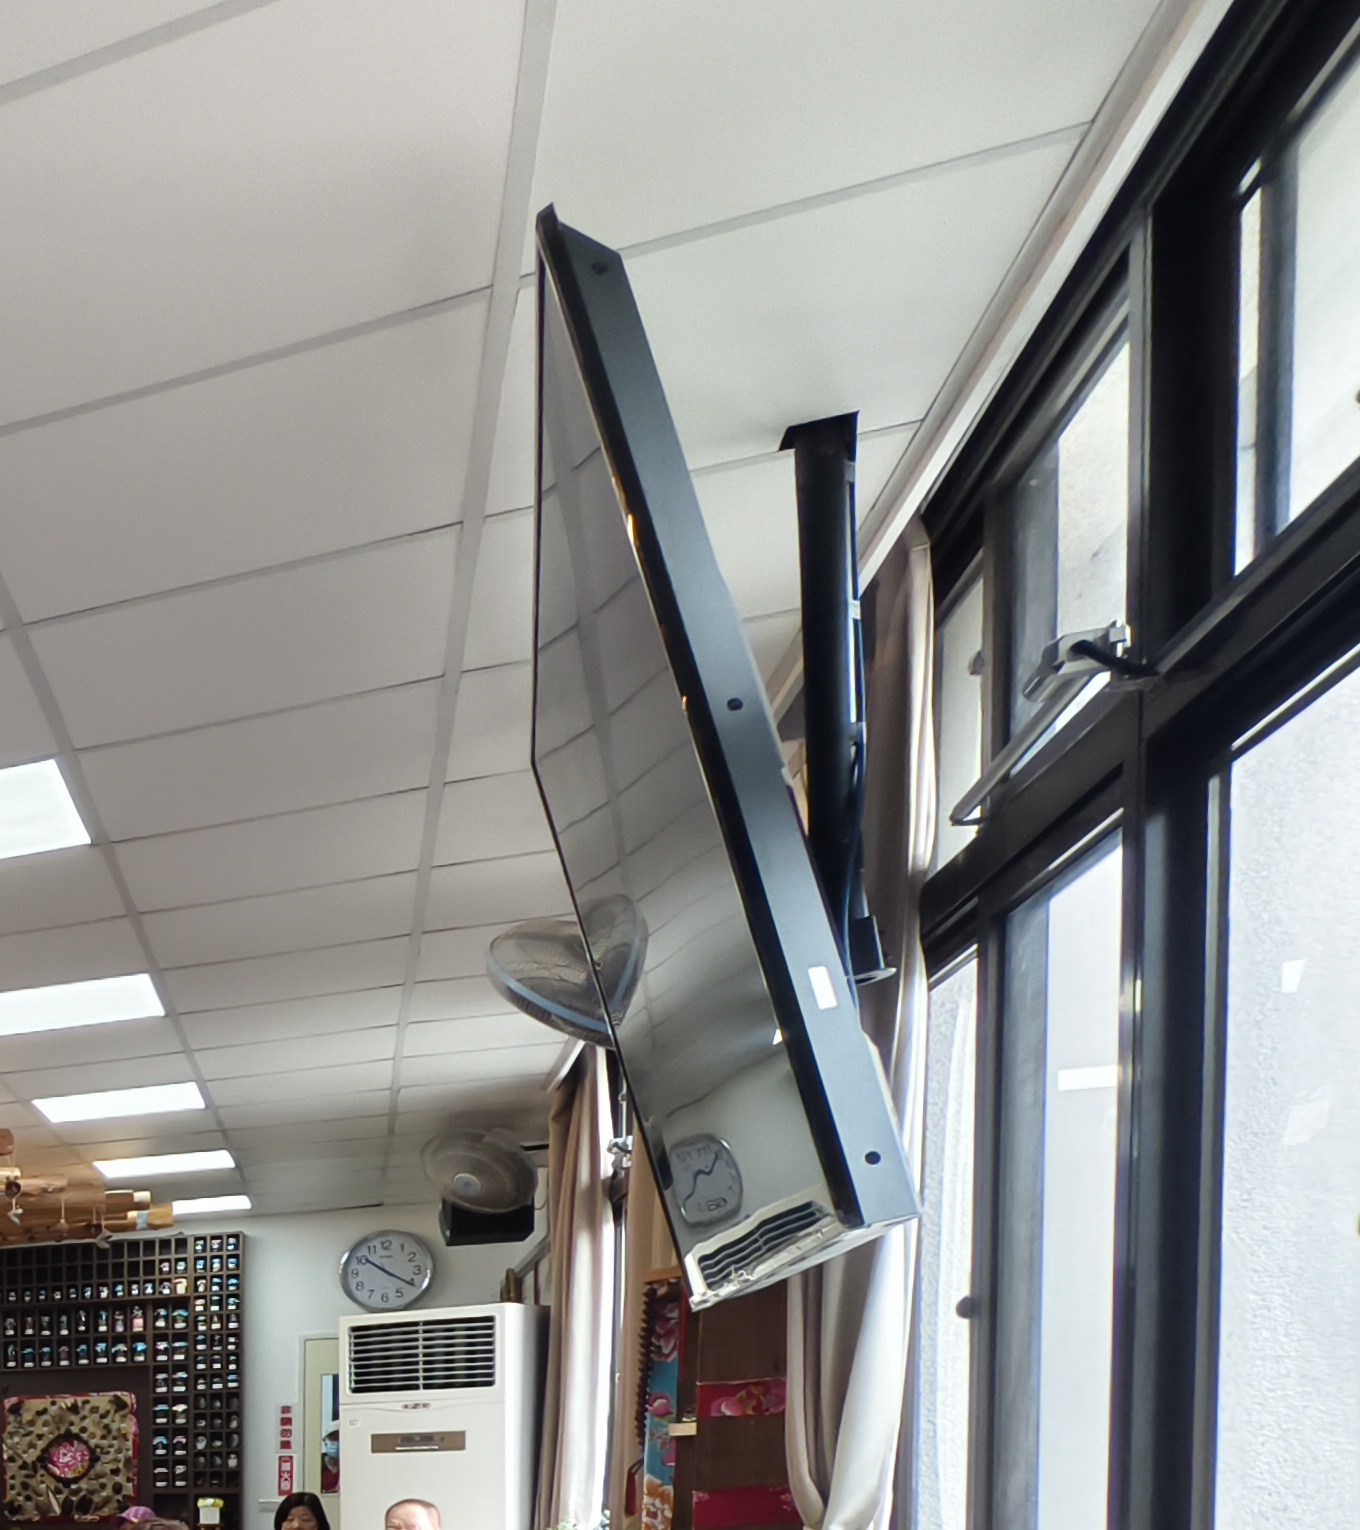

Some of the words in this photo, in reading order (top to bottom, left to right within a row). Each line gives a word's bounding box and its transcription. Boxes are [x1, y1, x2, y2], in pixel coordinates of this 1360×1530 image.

[367, 1244, 377, 1255] 11
[380, 1239, 393, 1251] 12
[400, 1243, 405, 1253] 1
[407, 1251, 417, 1263] 2
[351, 1268, 359, 1279] 9
[412, 1264, 422, 1276] 3
[355, 1280, 365, 1292] 8
[367, 1289, 375, 1300] 7
[381, 1292, 390, 1303] 6
[395, 1287, 404, 1298] 5
